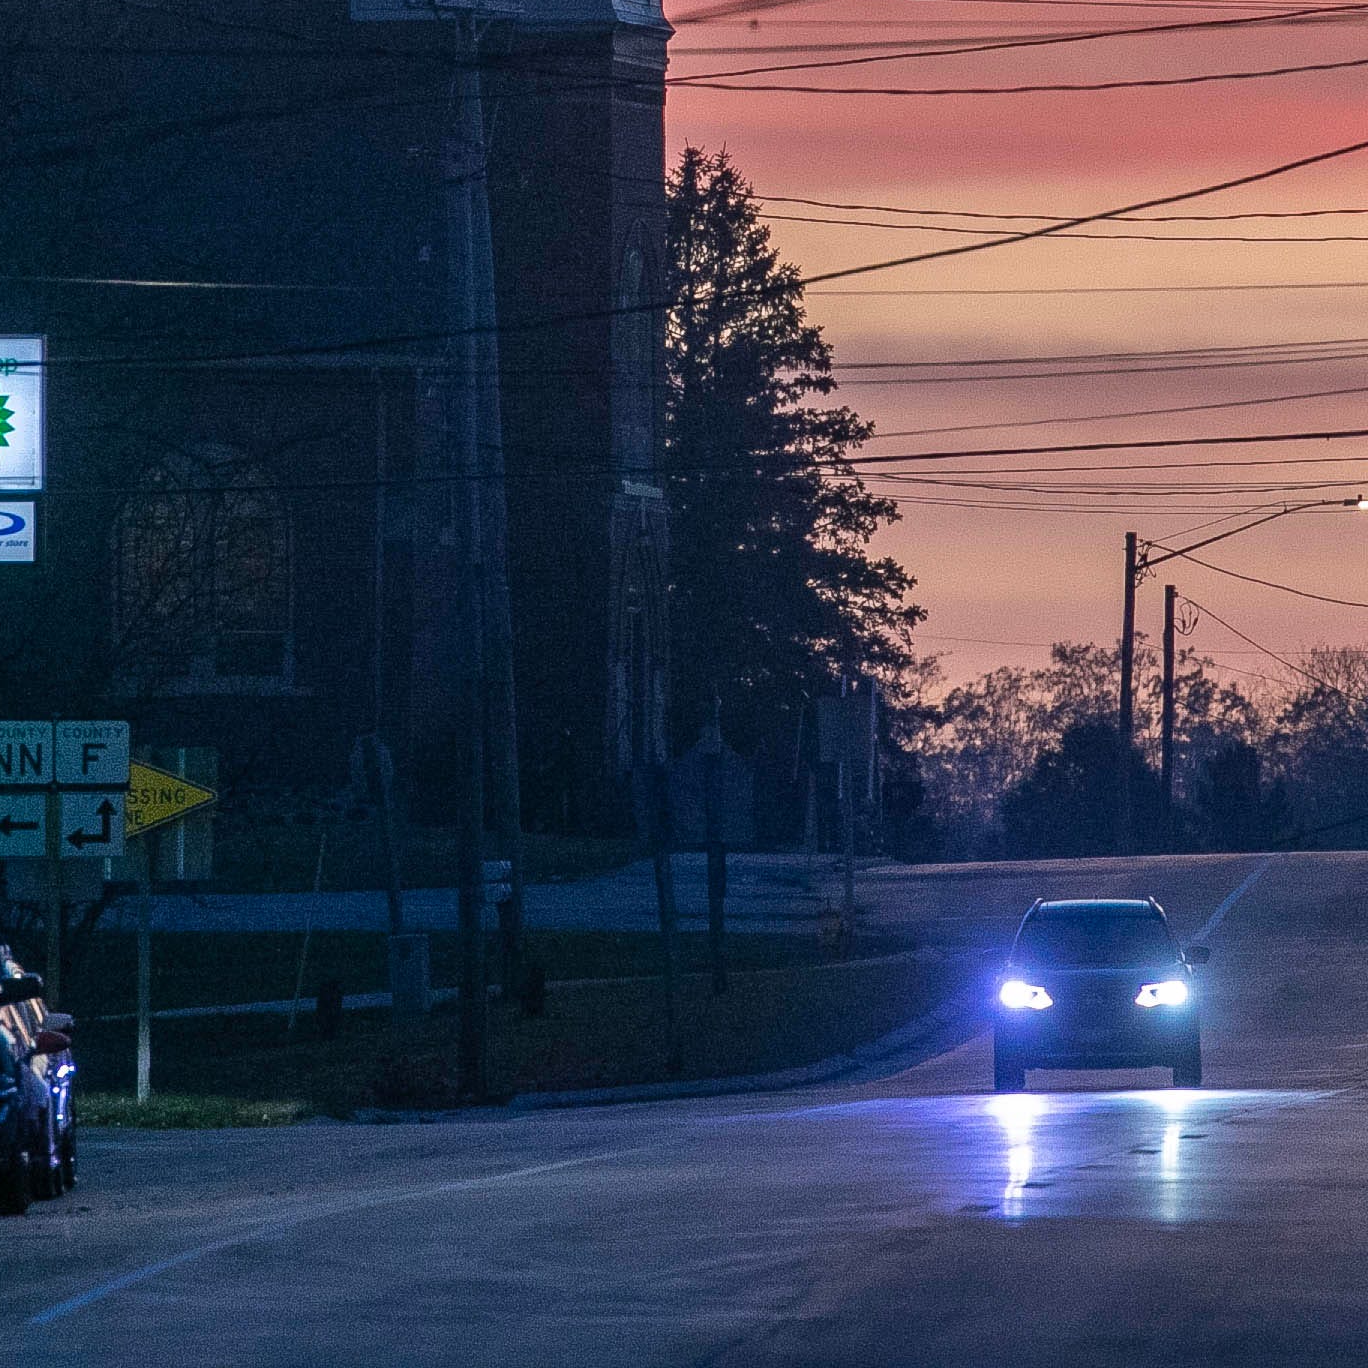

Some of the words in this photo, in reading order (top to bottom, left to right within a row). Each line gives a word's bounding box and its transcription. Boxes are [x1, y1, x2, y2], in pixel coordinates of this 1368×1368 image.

[5, 538, 29, 548] store
[62, 727, 123, 739] COUNTY
[82, 743, 107, 775] F
[128, 787, 186, 805] SSING
